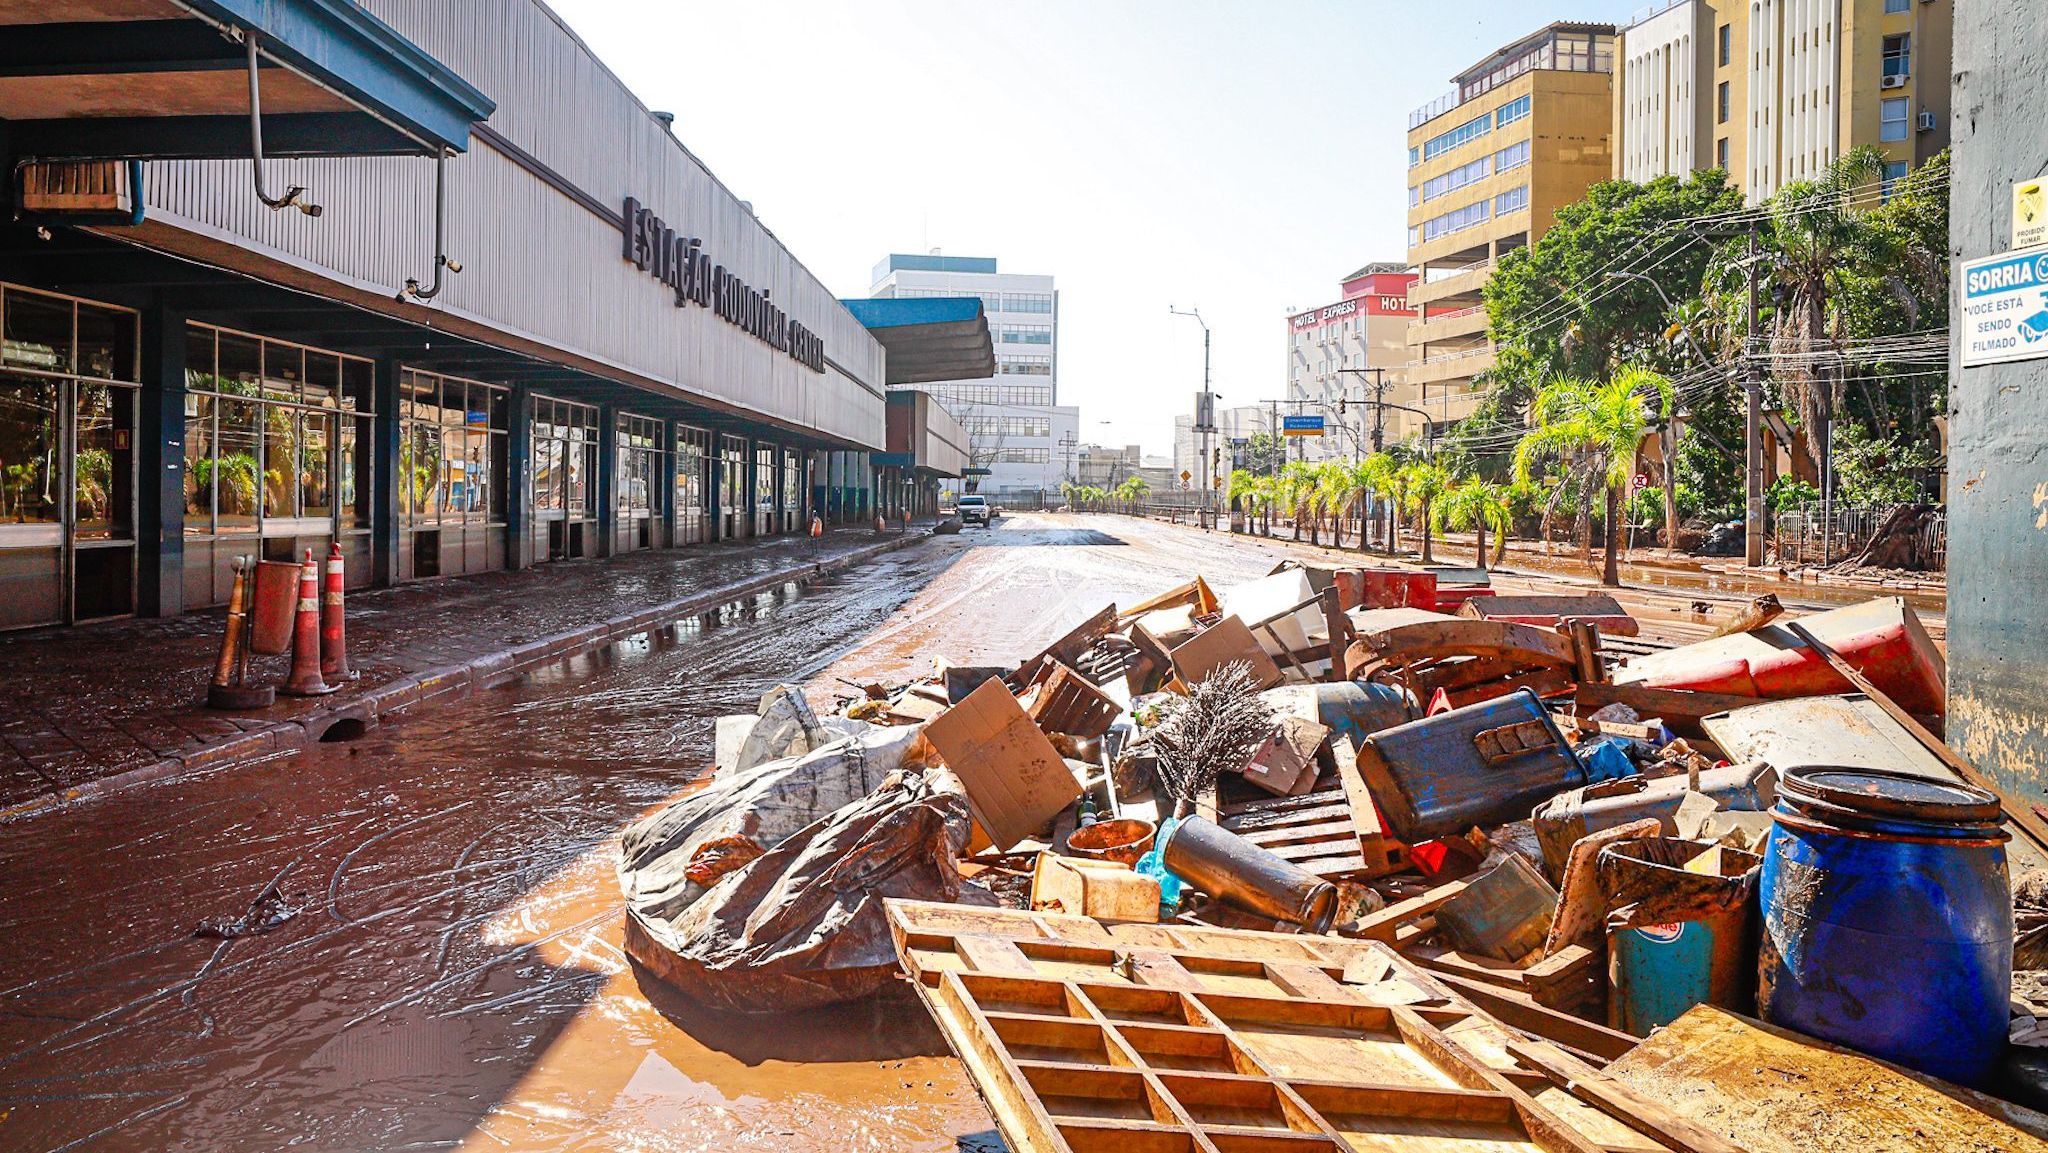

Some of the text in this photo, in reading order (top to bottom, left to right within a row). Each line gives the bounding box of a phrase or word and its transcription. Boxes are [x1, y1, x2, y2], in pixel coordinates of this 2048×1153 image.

[2017, 226, 2046, 238] PROIBIDO
[2020, 235, 2041, 245] FUMAR
[623, 196, 713, 308] ESTAÇÃO
[713, 265, 788, 353] RODOVIÁRIA
[1968, 261, 2034, 294] SORRIA
[1381, 296, 1418, 311] HOT
[1968, 295, 2024, 316] VOCÊ ESTÁ
[1295, 300, 1357, 329] HOTEL EXPRESS
[1977, 318, 2012, 333] SENDO
[1972, 336, 2017, 352] FILMADO
